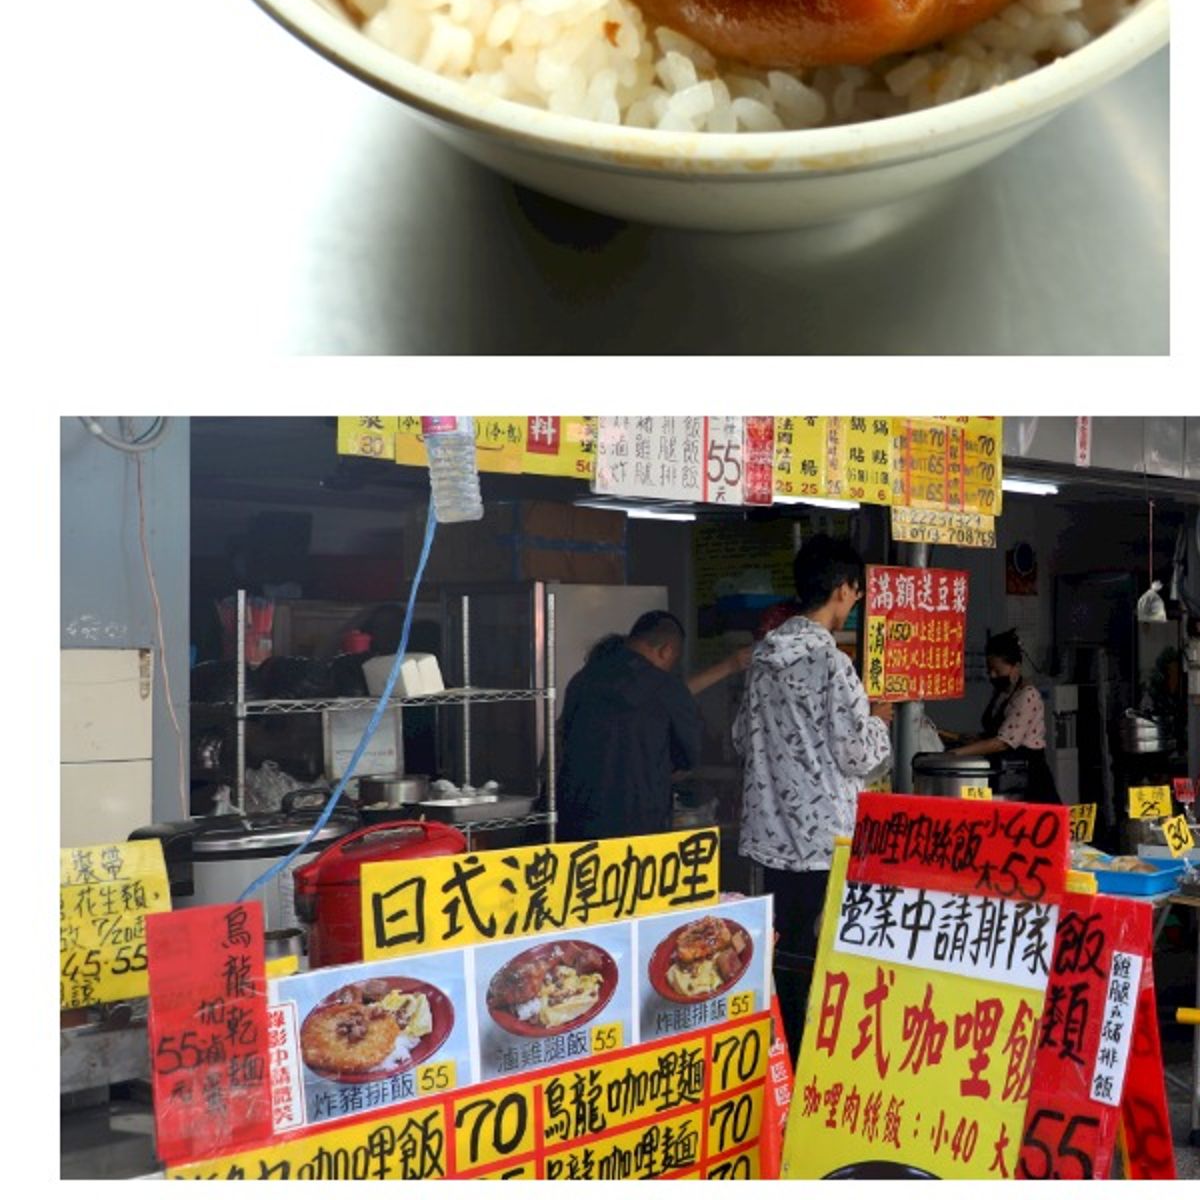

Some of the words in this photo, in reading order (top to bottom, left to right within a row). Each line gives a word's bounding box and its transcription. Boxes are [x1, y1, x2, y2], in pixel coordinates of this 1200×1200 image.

[707, 440, 741, 487] 55
[928, 456, 945, 476] 65
[978, 435, 995, 457] 70
[801, 483, 818, 495] 25
[978, 462, 995, 483] 70
[977, 489, 995, 507] 70
[869, 571, 968, 614] 滿額送豆漿
[1167, 818, 1189, 851] 30
[371, 831, 720, 949] 日式濃厚咖哩
[839, 883, 1050, 976] 營業中請排隊
[655, 1001, 727, 1035] 炸腿排飯
[730, 995, 750, 1016] 55
[156, 1030, 203, 1076] 55
[497, 1031, 588, 1074] 滷雞腿飯
[592, 1027, 618, 1051] 55
[313, 1074, 415, 1120] 炸豬排飯
[421, 1065, 449, 1091] 55
[543, 1047, 705, 1141] 烏龍咖哩麵
[712, 1028, 761, 1090] 70
[455, 1098, 527, 1163] 70
[709, 1093, 753, 1152] 70
[1017, 1109, 1101, 1180] 55
